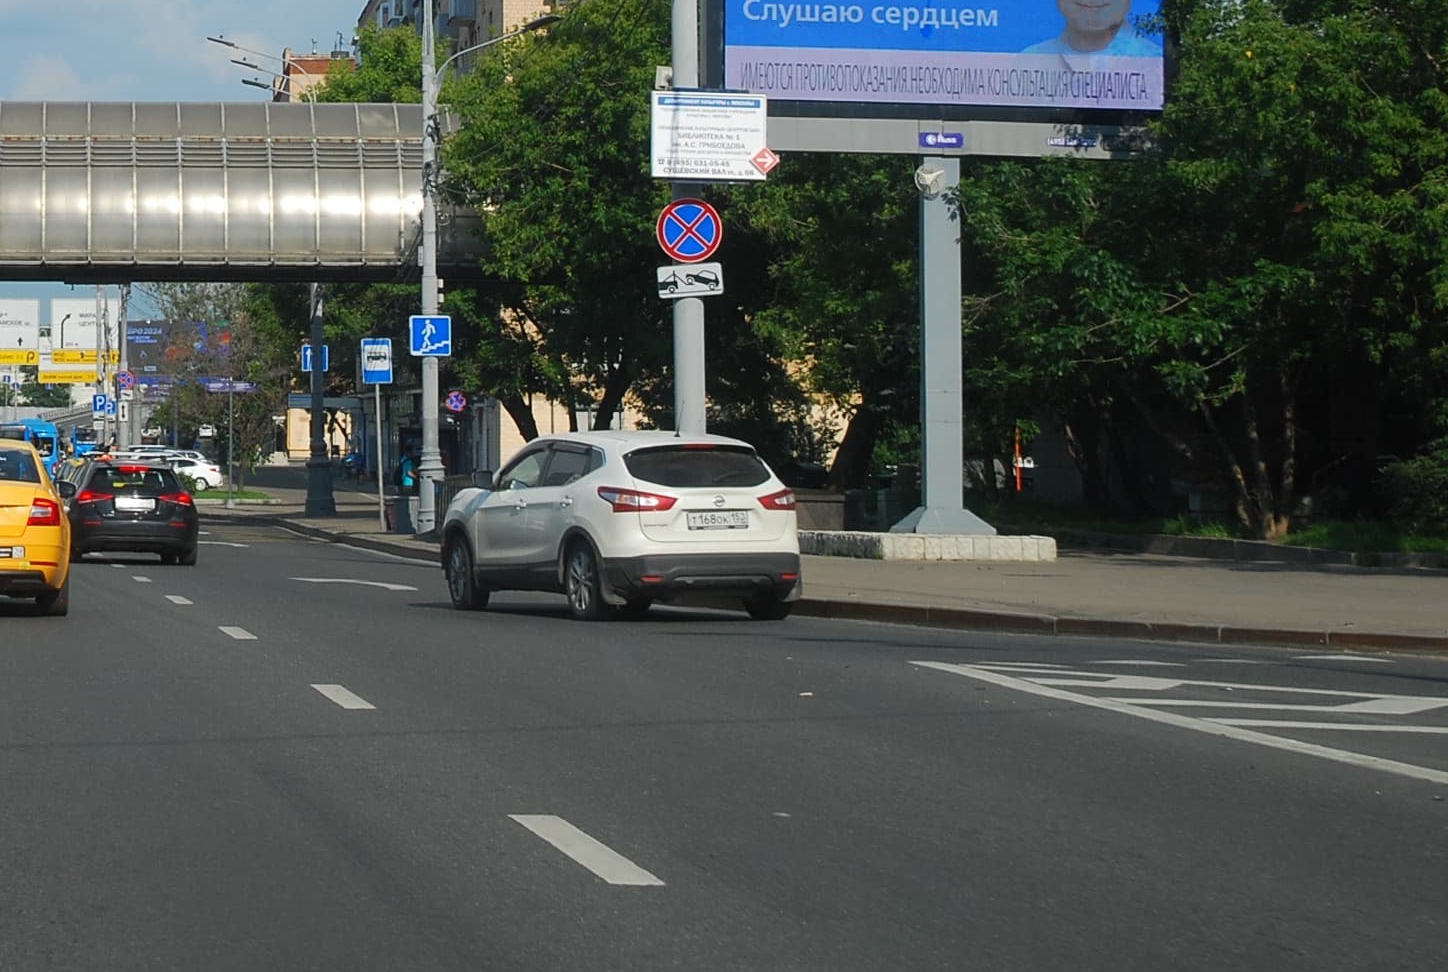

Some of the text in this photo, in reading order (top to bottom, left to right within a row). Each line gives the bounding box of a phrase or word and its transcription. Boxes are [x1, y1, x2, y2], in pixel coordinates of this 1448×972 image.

[871, 5, 998, 31] сердцем
[740, 62, 793, 90] ИМЕЮТСЯ
[911, 66, 985, 99] НЕОБХОДИМА
[988, 68, 1068, 102] КОНСУЛЬТАЦИЯ
[692, 514, 729, 525] Т168ОК
